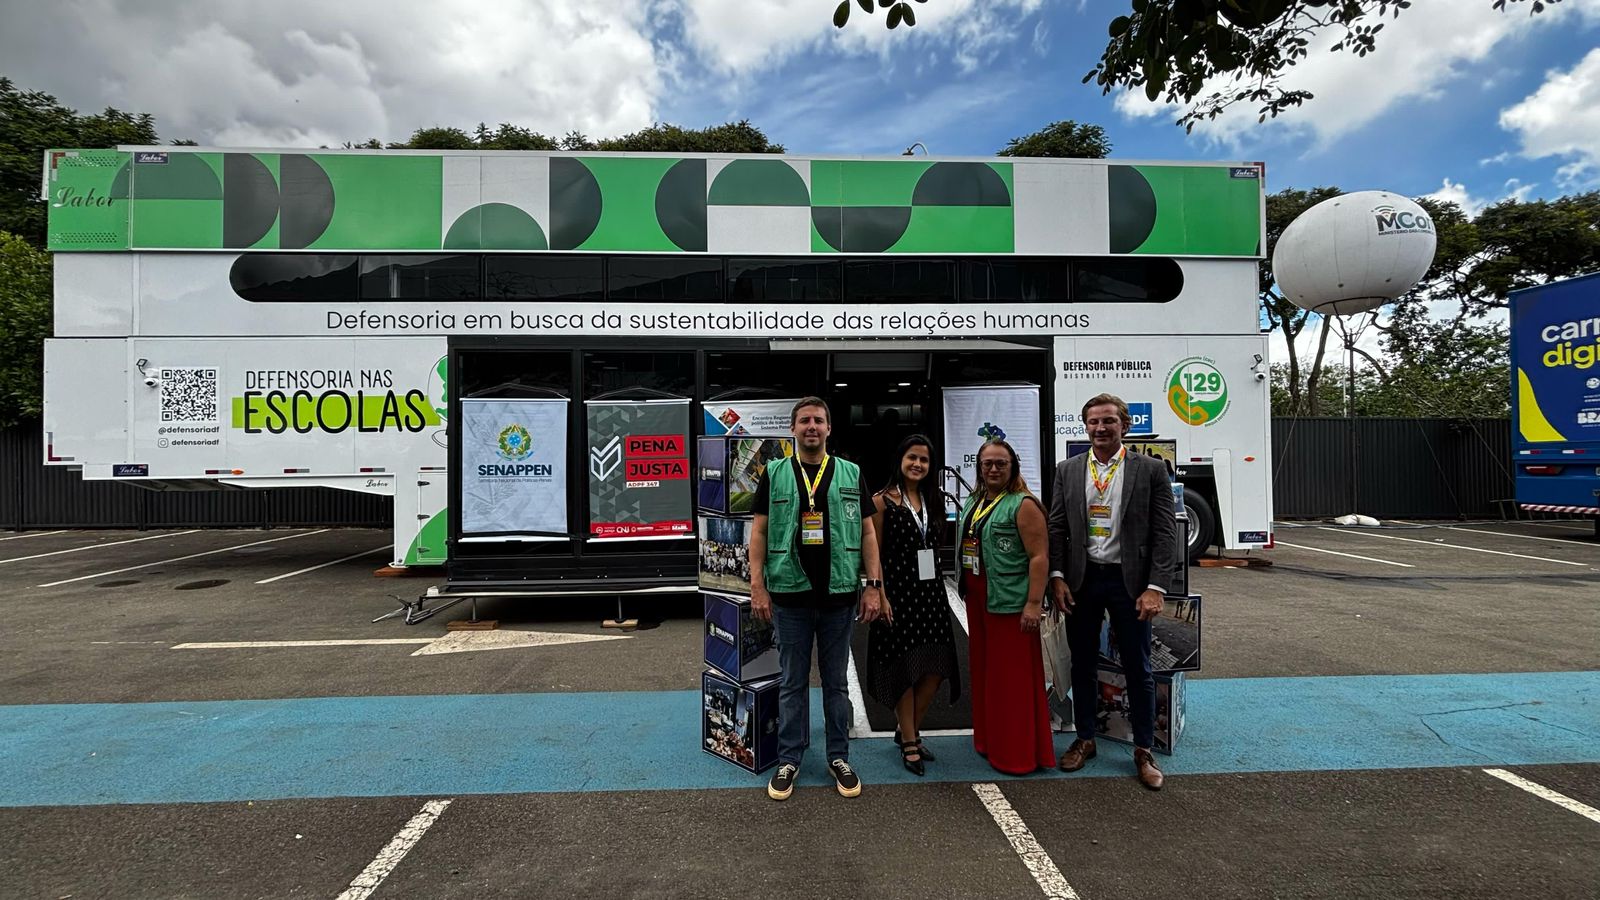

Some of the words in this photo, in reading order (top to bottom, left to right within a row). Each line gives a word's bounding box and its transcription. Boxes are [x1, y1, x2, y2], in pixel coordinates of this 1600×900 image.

[141, 153, 163, 161] Labor
[52, 186, 114, 208] Labor
[326, 310, 456, 330] Defensoria
[463, 315, 502, 329] em
[510, 310, 584, 330] busca
[591, 310, 622, 329] da
[629, 310, 824, 330] sustentabilidade
[832, 311, 873, 330] das
[880, 310, 976, 334] relações
[983, 310, 1090, 329] humanas
[1063, 361, 1115, 371] DEFENSORIA
[1115, 358, 1152, 371] PÚBLICA
[245, 370, 354, 389] DEFENSORIA
[360, 369, 393, 388] NAS
[1183, 372, 1221, 392] 129
[243, 389, 426, 434] ESCOLAS
[1131, 414, 1149, 425] DF
[158, 426, 220, 435] @defensoriadf
[630, 440, 677, 452] PENA
[478, 464, 552, 476] SENAPPEN
[630, 463, 683, 476] JUSTA
[1176, 467, 1187, 476] bor
[366, 479, 388, 488] Labor
